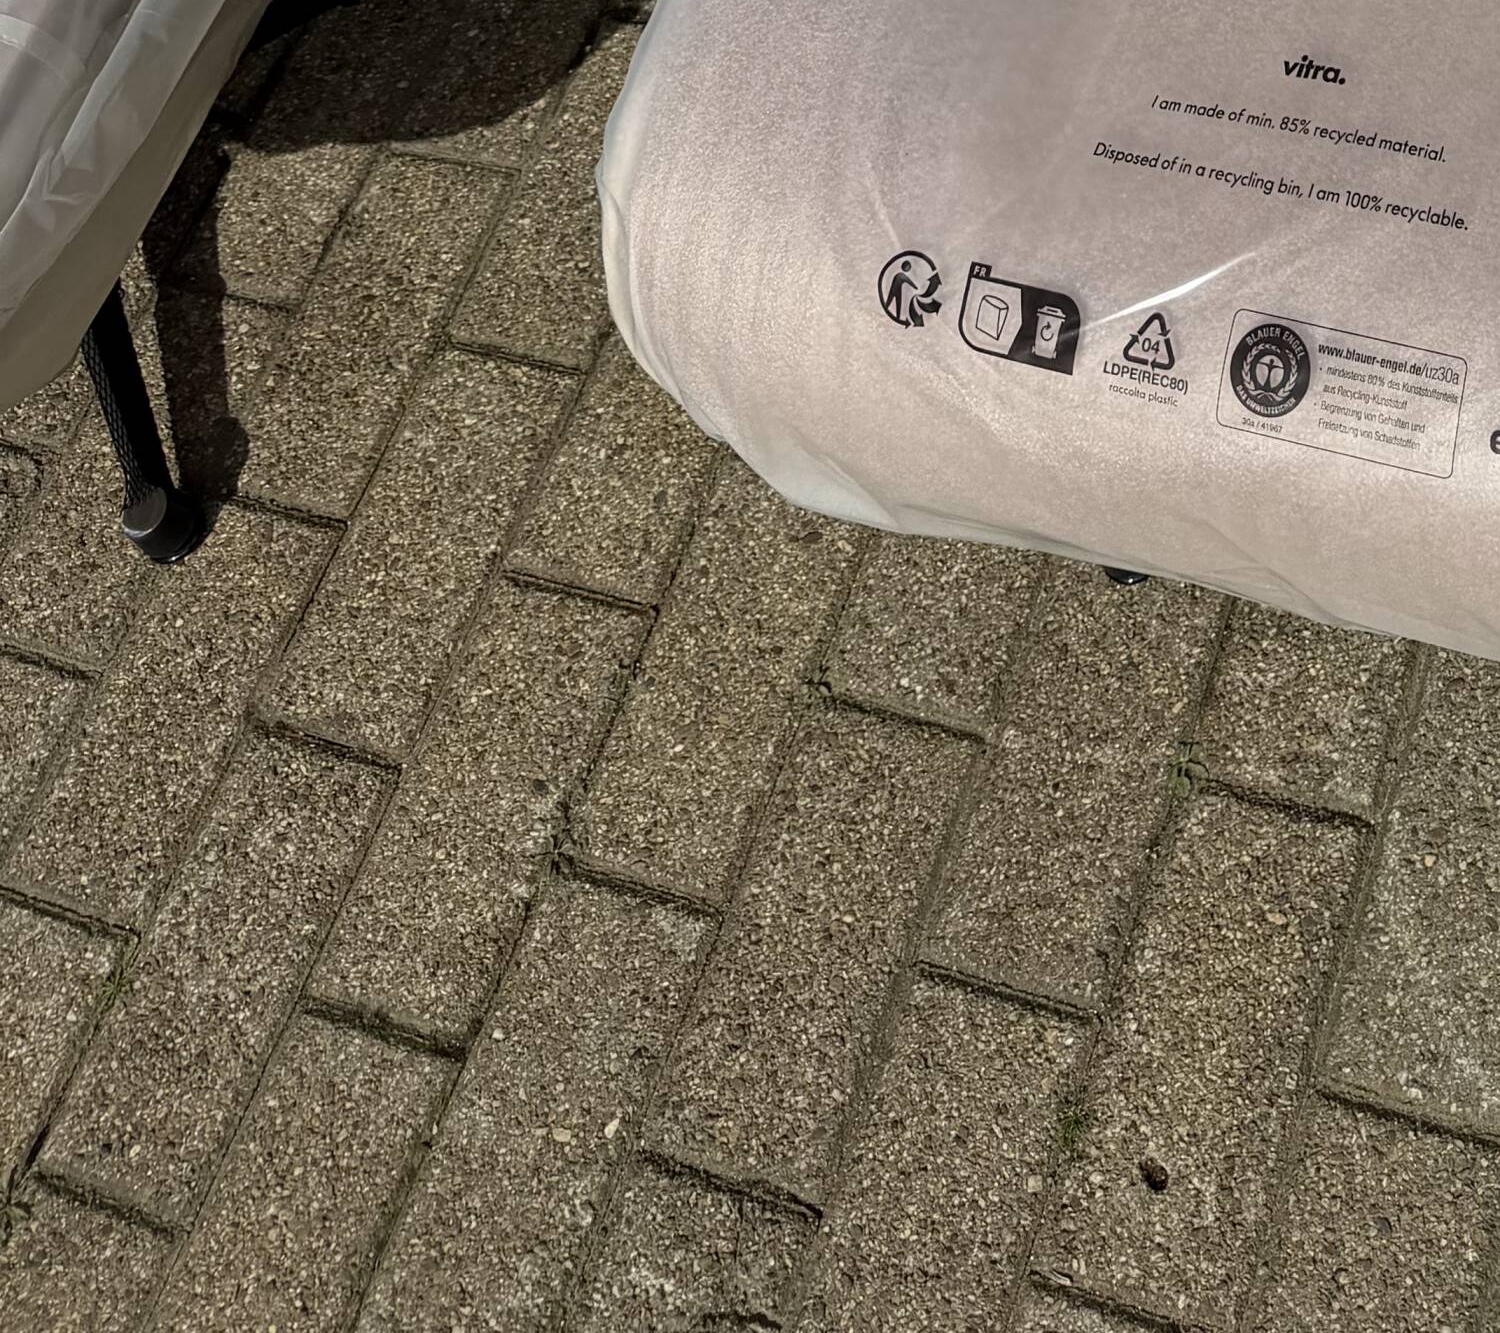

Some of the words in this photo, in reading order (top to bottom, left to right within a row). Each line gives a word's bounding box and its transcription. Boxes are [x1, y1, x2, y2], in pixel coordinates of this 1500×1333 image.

[1283, 55, 1346, 85] vitra.
[1151, 95, 1159, 109] I
[1159, 99, 1182, 112] am
[1184, 101, 1225, 121] made
[1228, 109, 1245, 122] of
[1246, 113, 1276, 130] min.
[1280, 117, 1311, 135] 85%
[1313, 123, 1377, 148] recycled
[1379, 136, 1446, 163] material.
[1093, 142, 1159, 168] Disposed
[1161, 157, 1179, 171] of
[1178, 158, 1192, 174] in
[1195, 165, 1206, 177] a
[1209, 167, 1274, 195] recycling
[1278, 178, 1304, 199] bin,
[1307, 184, 1315, 198] I
[1316, 189, 1340, 204] am
[1345, 190, 1382, 212] 100%
[1385, 200, 1469, 231] recyclable.
[973, 265, 988, 278] FR
[1142, 336, 1161, 354] 04
[1246, 327, 1281, 346] BLAUER
[1283, 331, 1305, 359] ENGEL
[1103, 361, 1189, 395] LDPE(REC80)
[1318, 344, 1459, 385] www.blauer-engel.de/uz30a
[1109, 383, 1146, 401] raccolta
[1148, 391, 1178, 407] plastic
